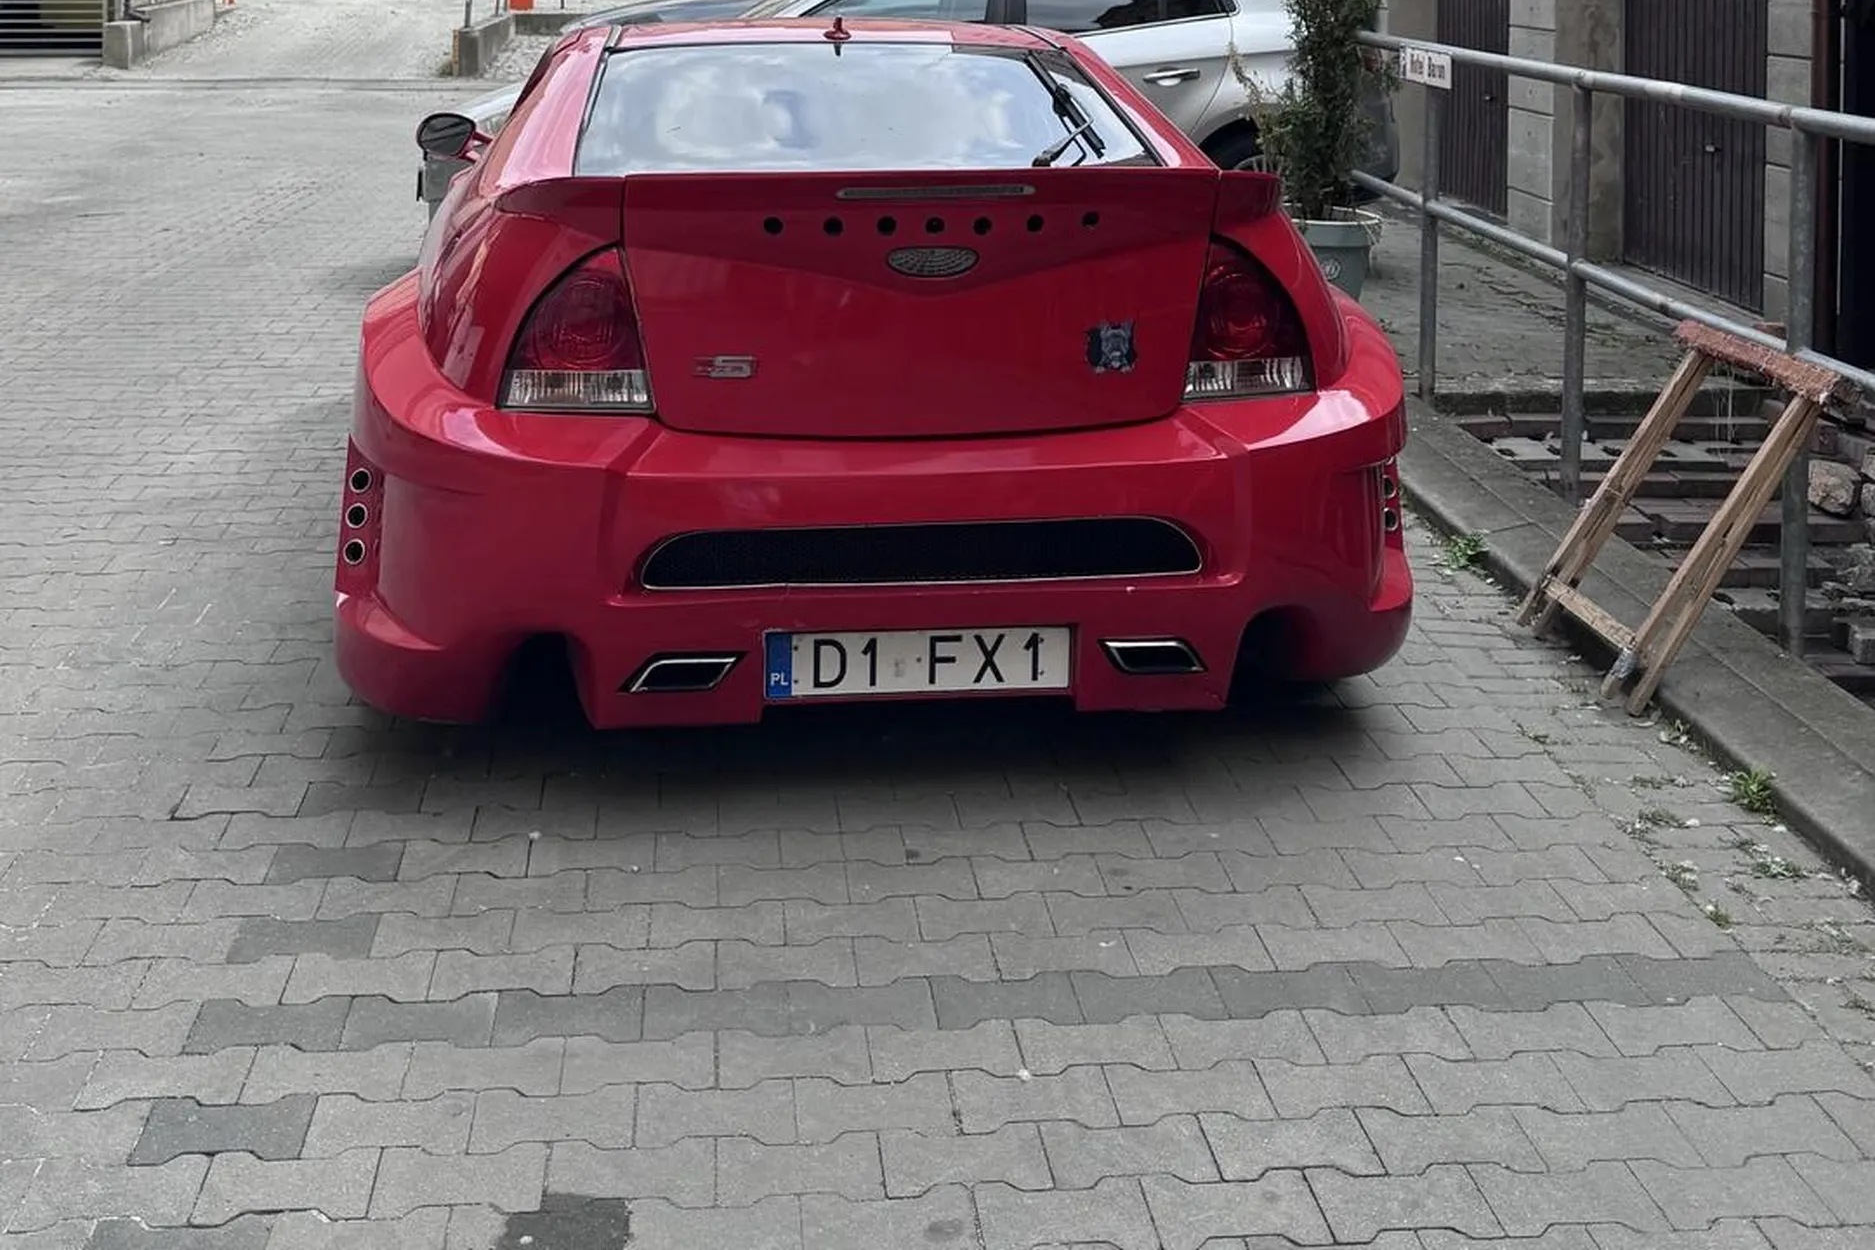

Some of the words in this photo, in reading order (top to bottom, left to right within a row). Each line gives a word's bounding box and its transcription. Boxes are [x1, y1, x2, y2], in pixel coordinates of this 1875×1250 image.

[813, 637, 878, 688] D1
[928, 632, 1040, 685] FX1
[770, 672, 789, 686] PL
